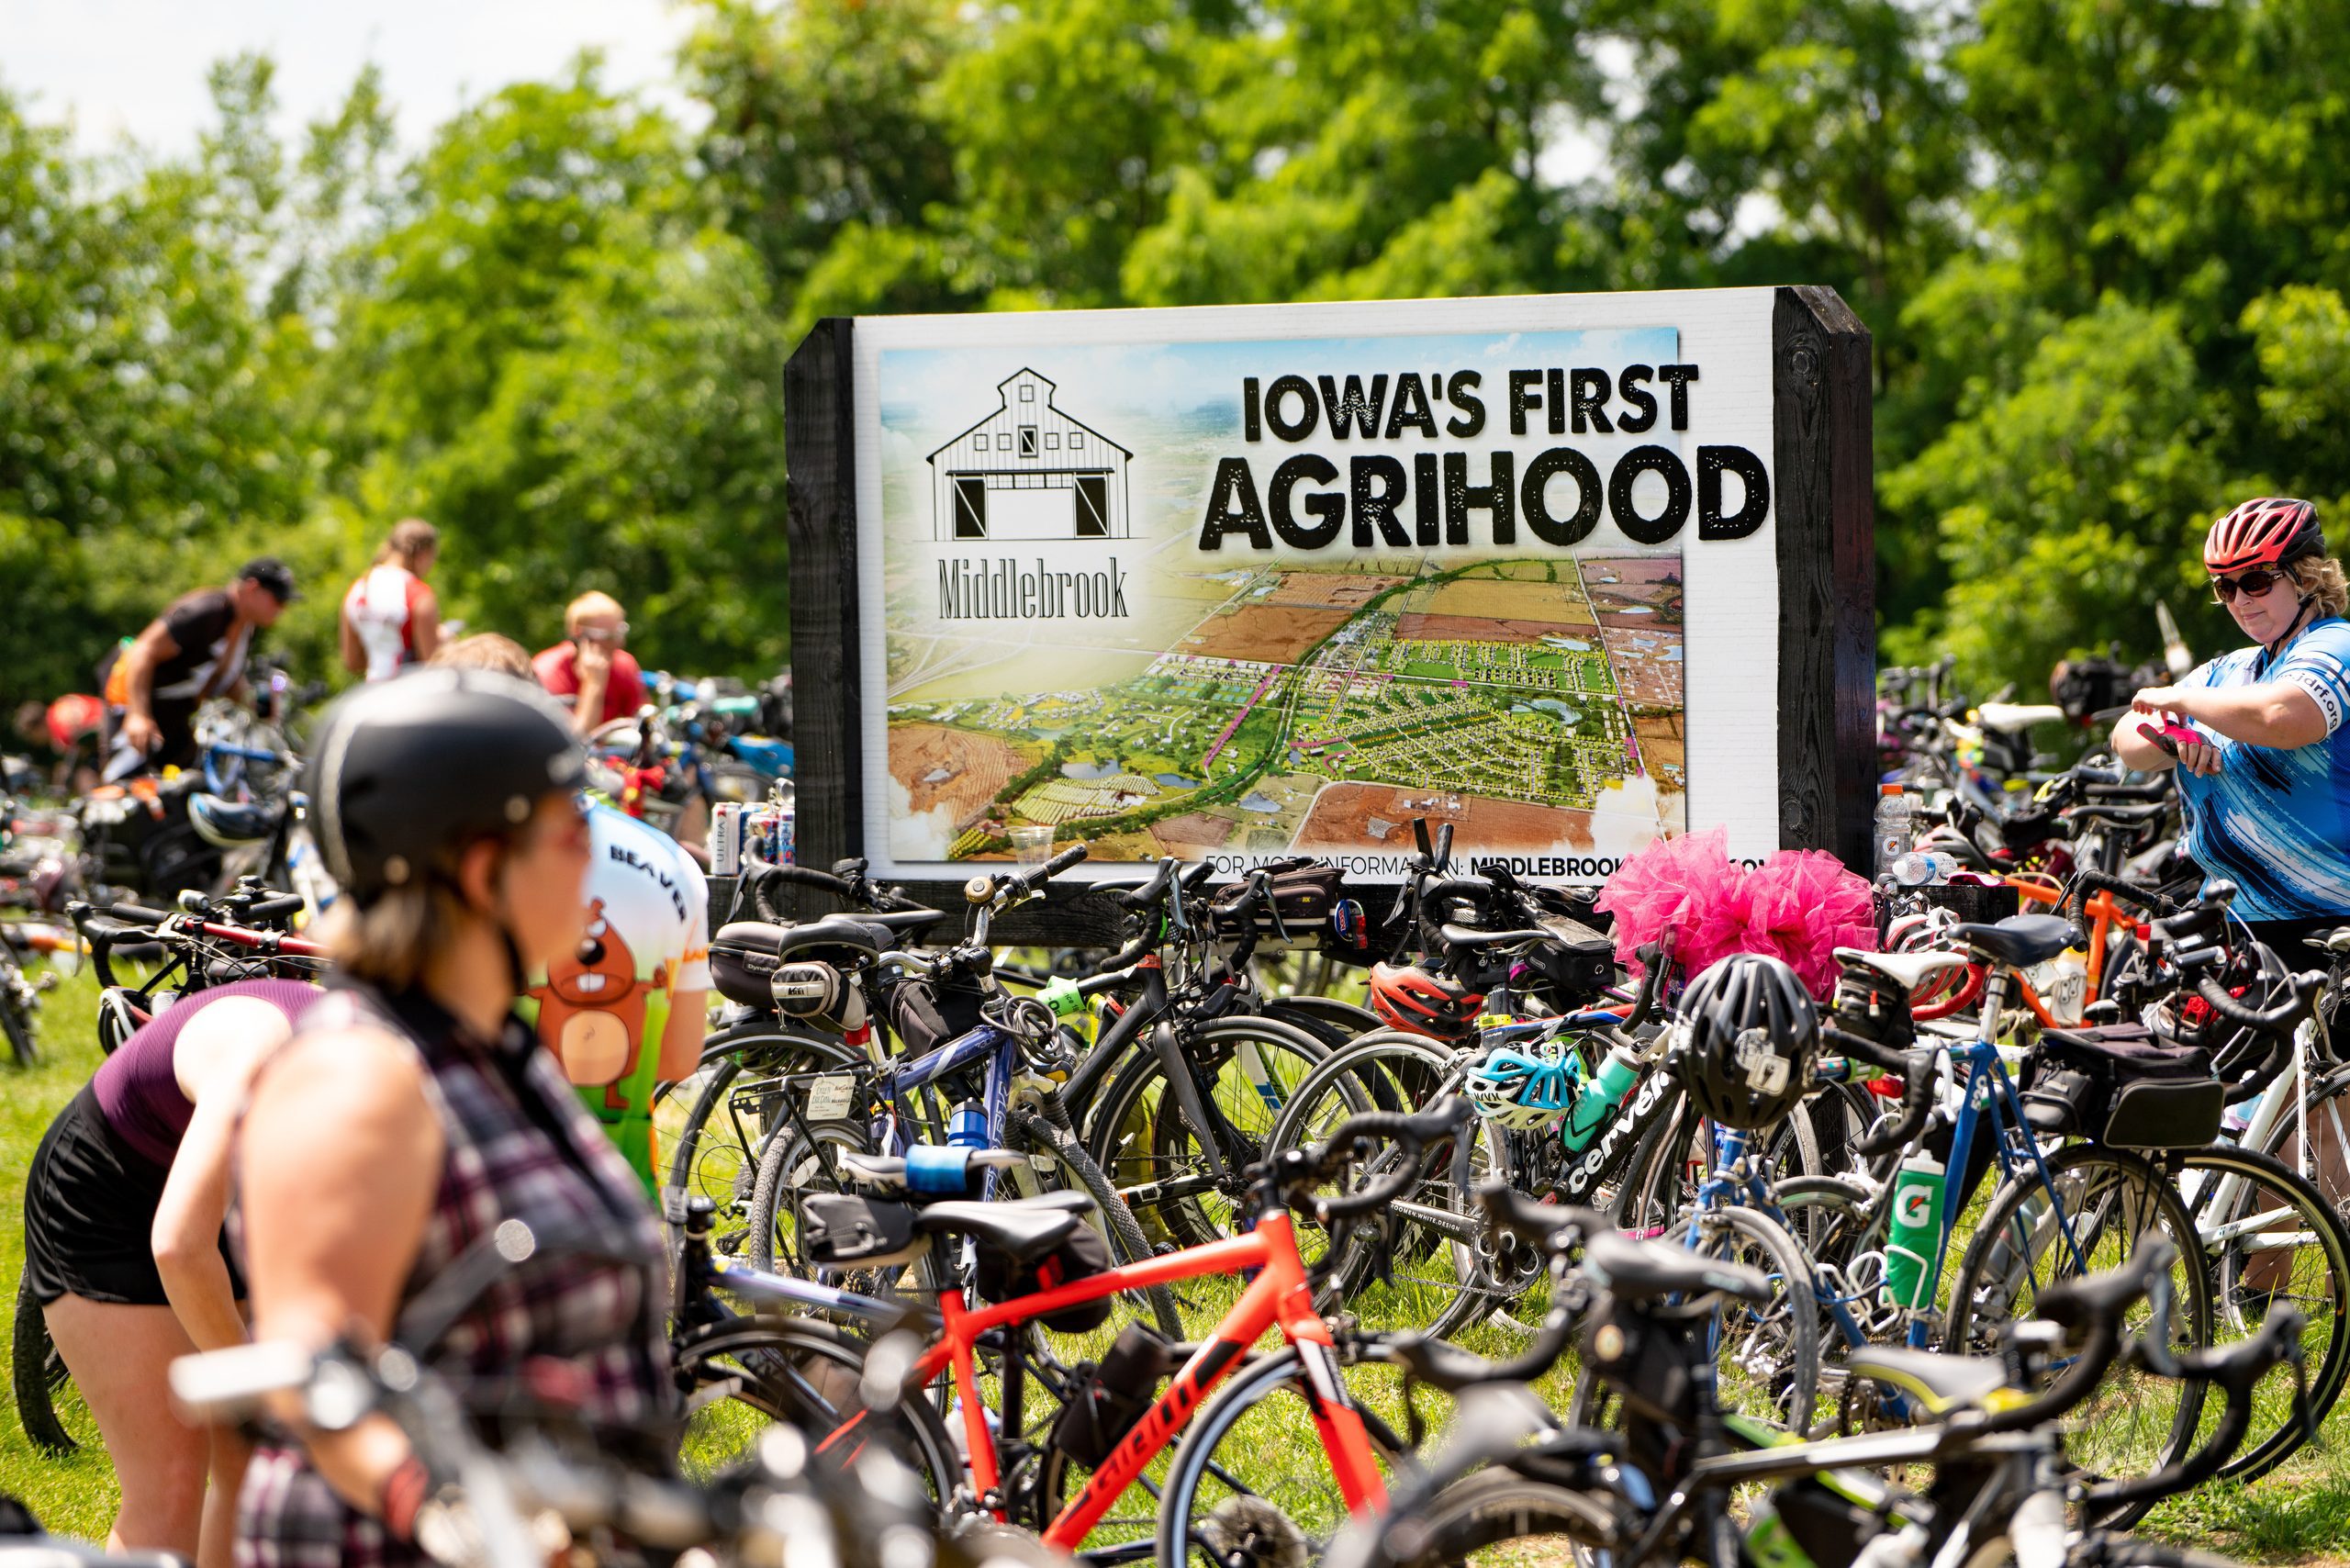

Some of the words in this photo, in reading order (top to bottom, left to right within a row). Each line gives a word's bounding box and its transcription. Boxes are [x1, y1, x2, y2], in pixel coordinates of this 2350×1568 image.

[1243, 369, 1486, 442] IOWA'S
[1508, 364, 1699, 435] FIRST
[1199, 444, 1771, 551] AGRIHOOD
[938, 556, 1130, 619] Middlebrook
[610, 845, 687, 924] BEAVER
[1895, 1183, 1934, 1228] G
